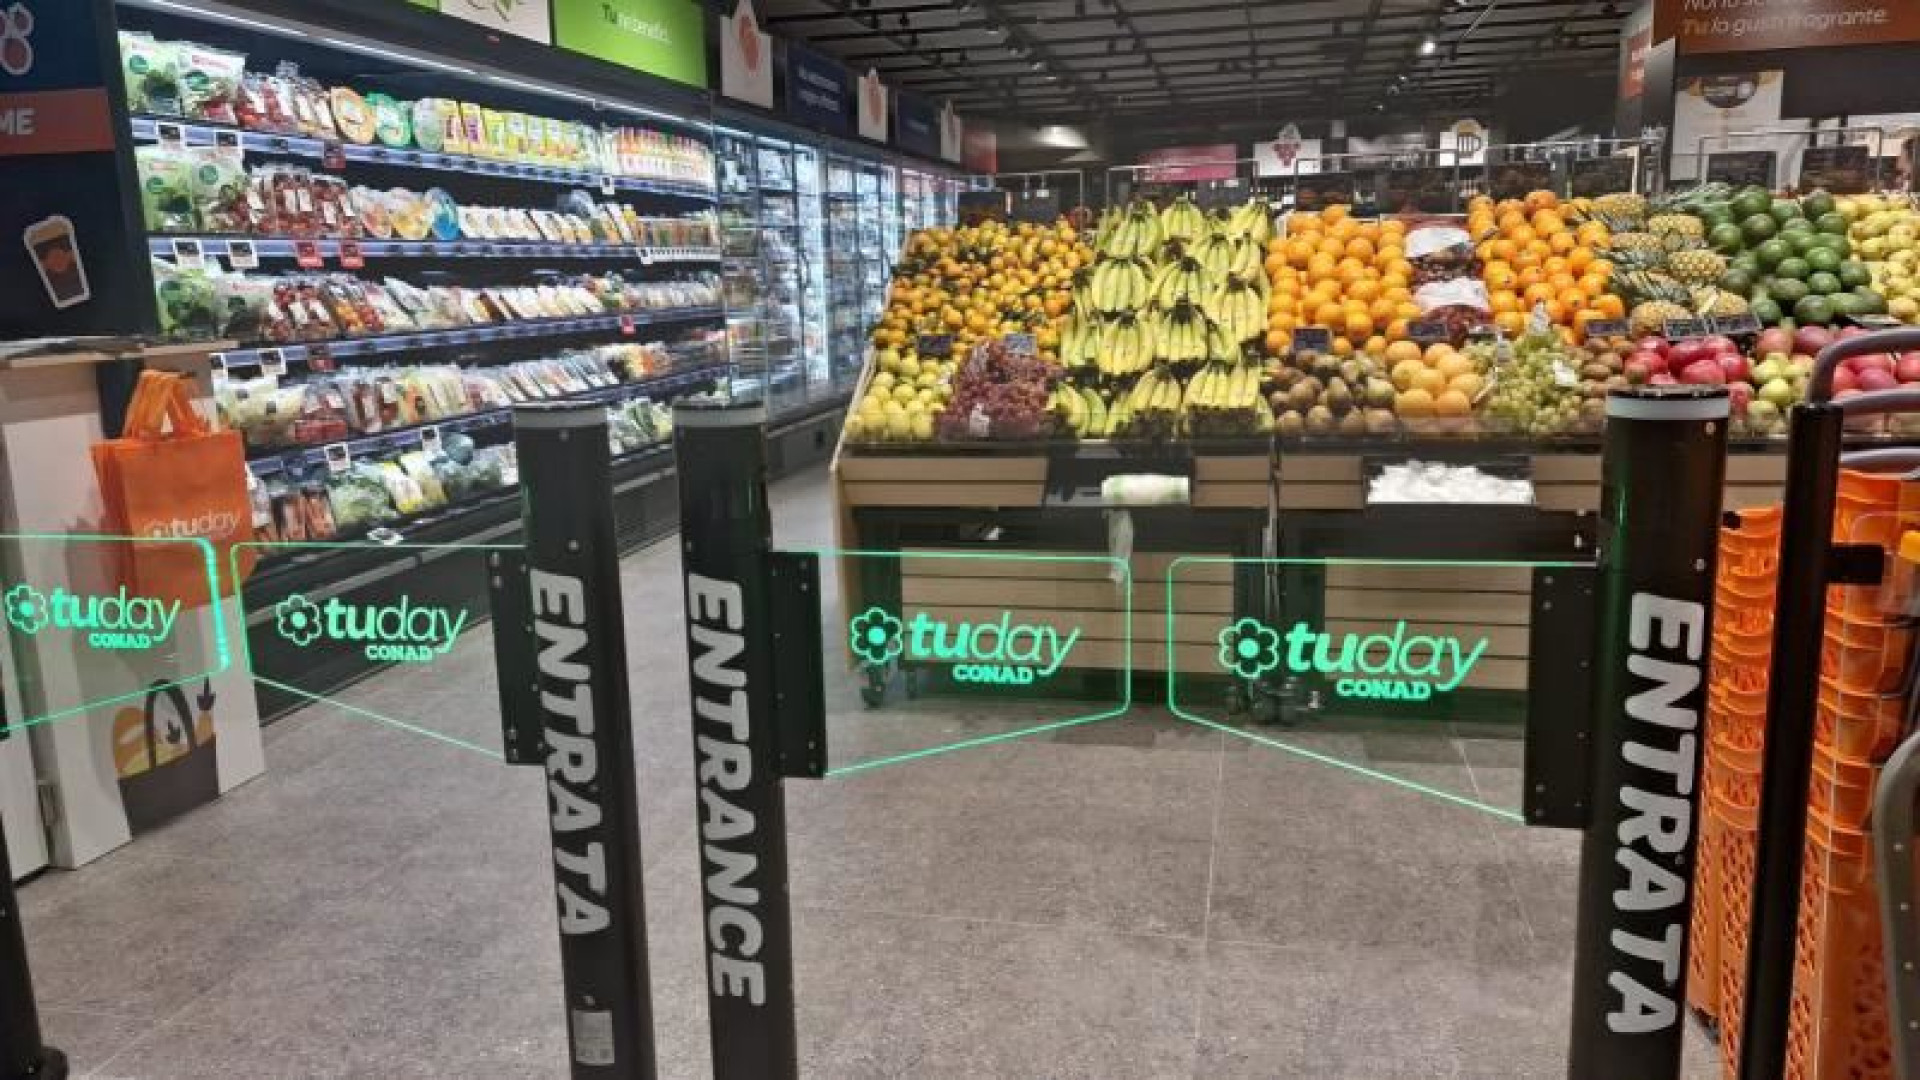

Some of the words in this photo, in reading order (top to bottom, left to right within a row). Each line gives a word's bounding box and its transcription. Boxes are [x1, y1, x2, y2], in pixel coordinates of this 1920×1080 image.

[50, 585, 181, 642] tuday
[89, 632, 152, 649] CONAD
[324, 594, 468, 653] tuday
[910, 610, 1082, 676] tuday
[364, 645, 434, 661] CONAD
[953, 664, 1033, 684] CONAD
[1285, 619, 1489, 692] tuday
[1336, 678, 1432, 699] CONAD
[530, 568, 612, 935] ENTRATA
[689, 573, 766, 1007] ENTRANCE
[1607, 593, 1705, 1033] ENTRATA
